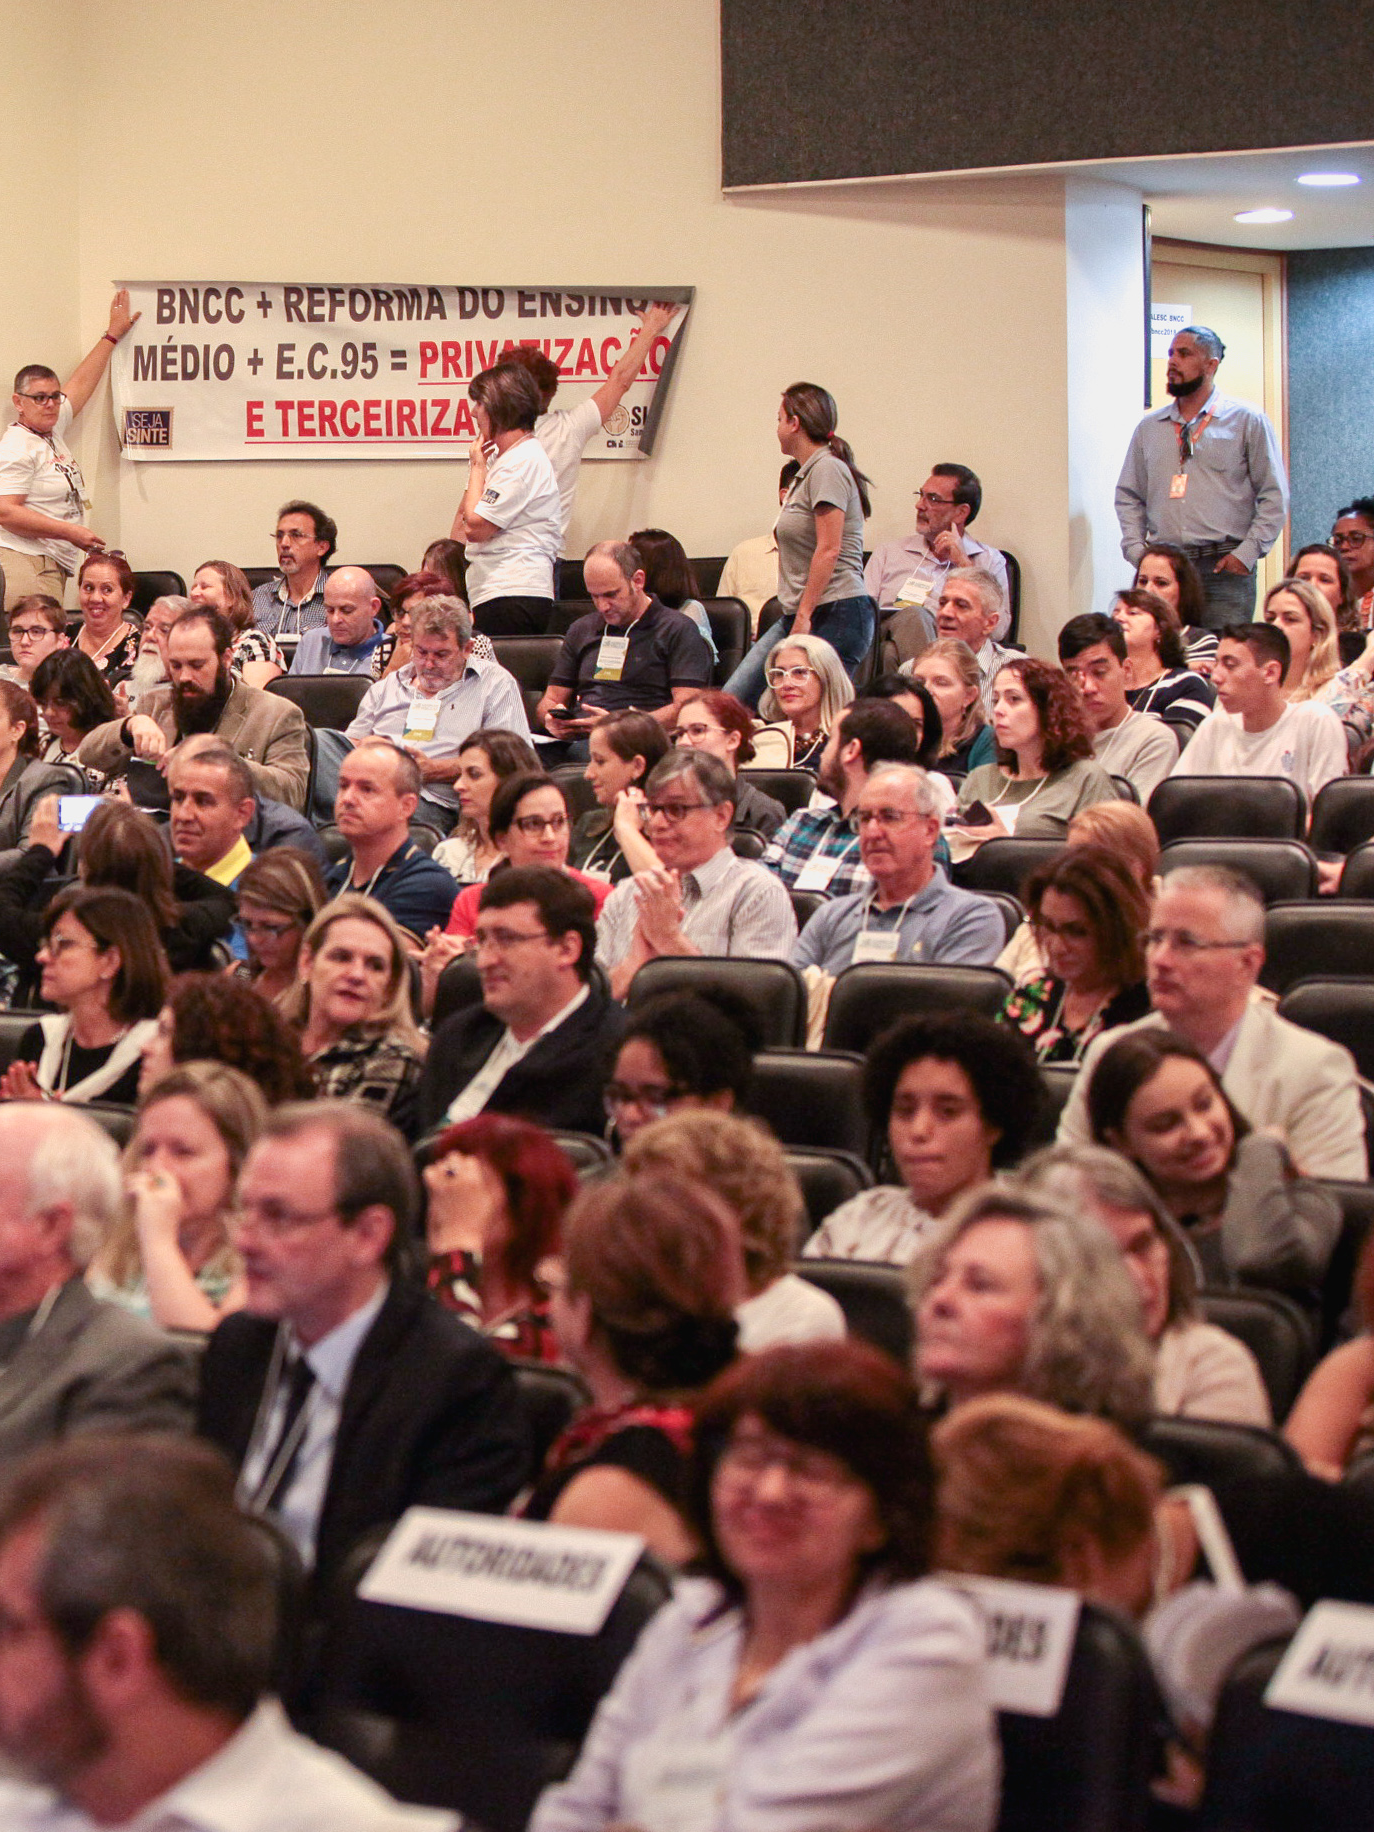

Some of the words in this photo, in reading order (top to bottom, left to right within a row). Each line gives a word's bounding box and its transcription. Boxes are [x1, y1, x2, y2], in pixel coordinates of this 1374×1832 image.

[156, 286, 246, 325] BNCC
[283, 286, 447, 323] REFORMA
[457, 286, 505, 320] DO
[133, 335, 235, 382] MÉDIO
[276, 341, 379, 380] E.C.95
[127, 427, 168, 444] SINTE
[131, 412, 163, 429] SEJA
[246, 400, 265, 438] E
[275, 398, 477, 438] TERCEIRIZA
